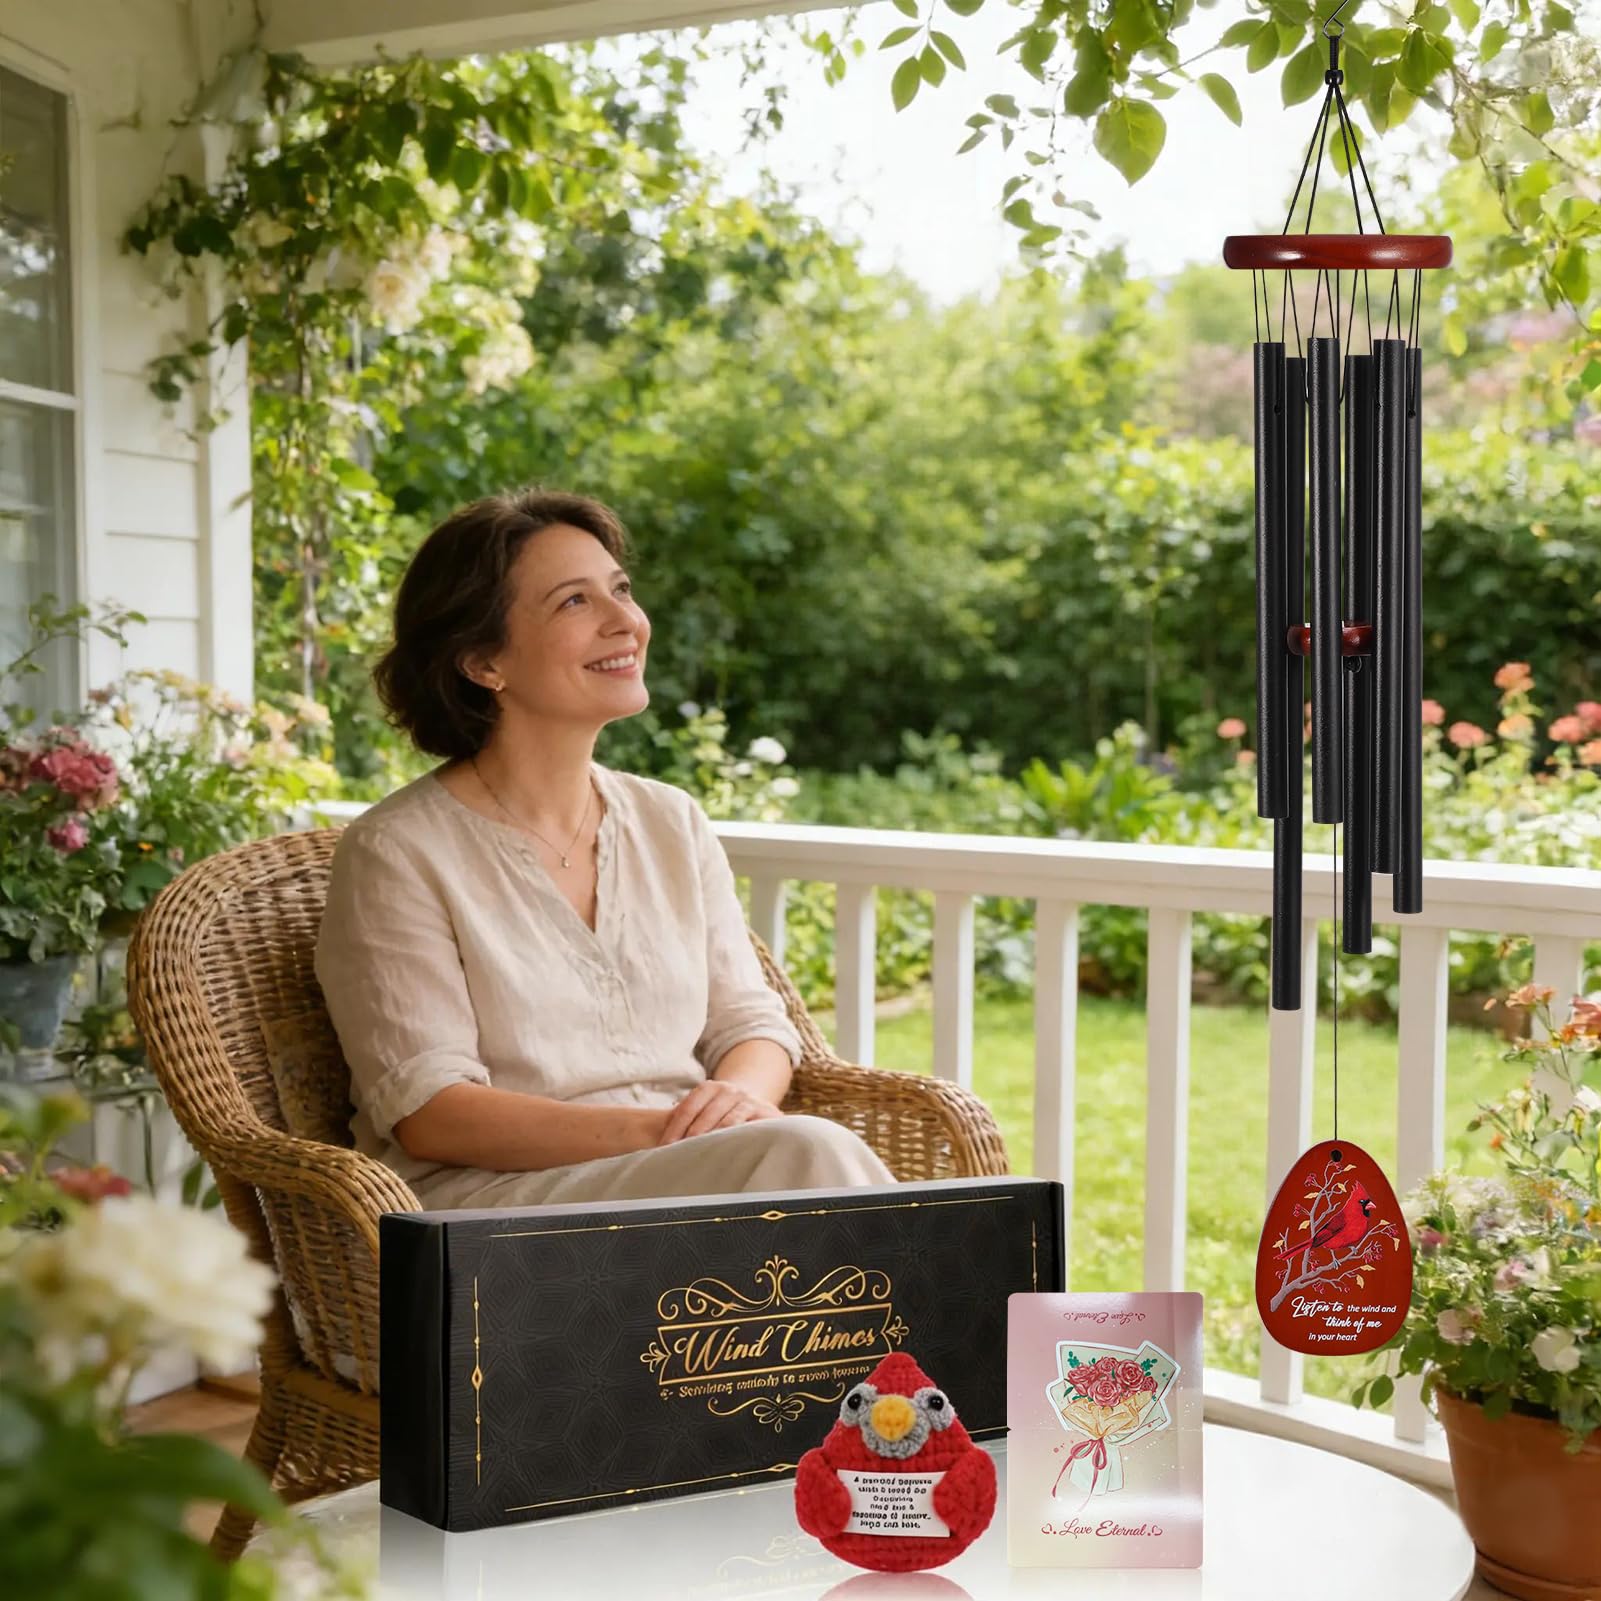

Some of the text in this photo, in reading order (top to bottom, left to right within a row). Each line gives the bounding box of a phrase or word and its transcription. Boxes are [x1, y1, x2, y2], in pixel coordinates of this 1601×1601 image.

[1291, 1296, 1330, 1318] Listen
[1328, 1301, 1344, 1312] to
[1322, 1317, 1382, 1333] think of me
[674, 1320, 875, 1374] Wind Chimes
[1317, 1334, 1335, 1342] your
[1336, 1333, 1357, 1341] heart
[1059, 1518, 1147, 1539] Love Eternal
